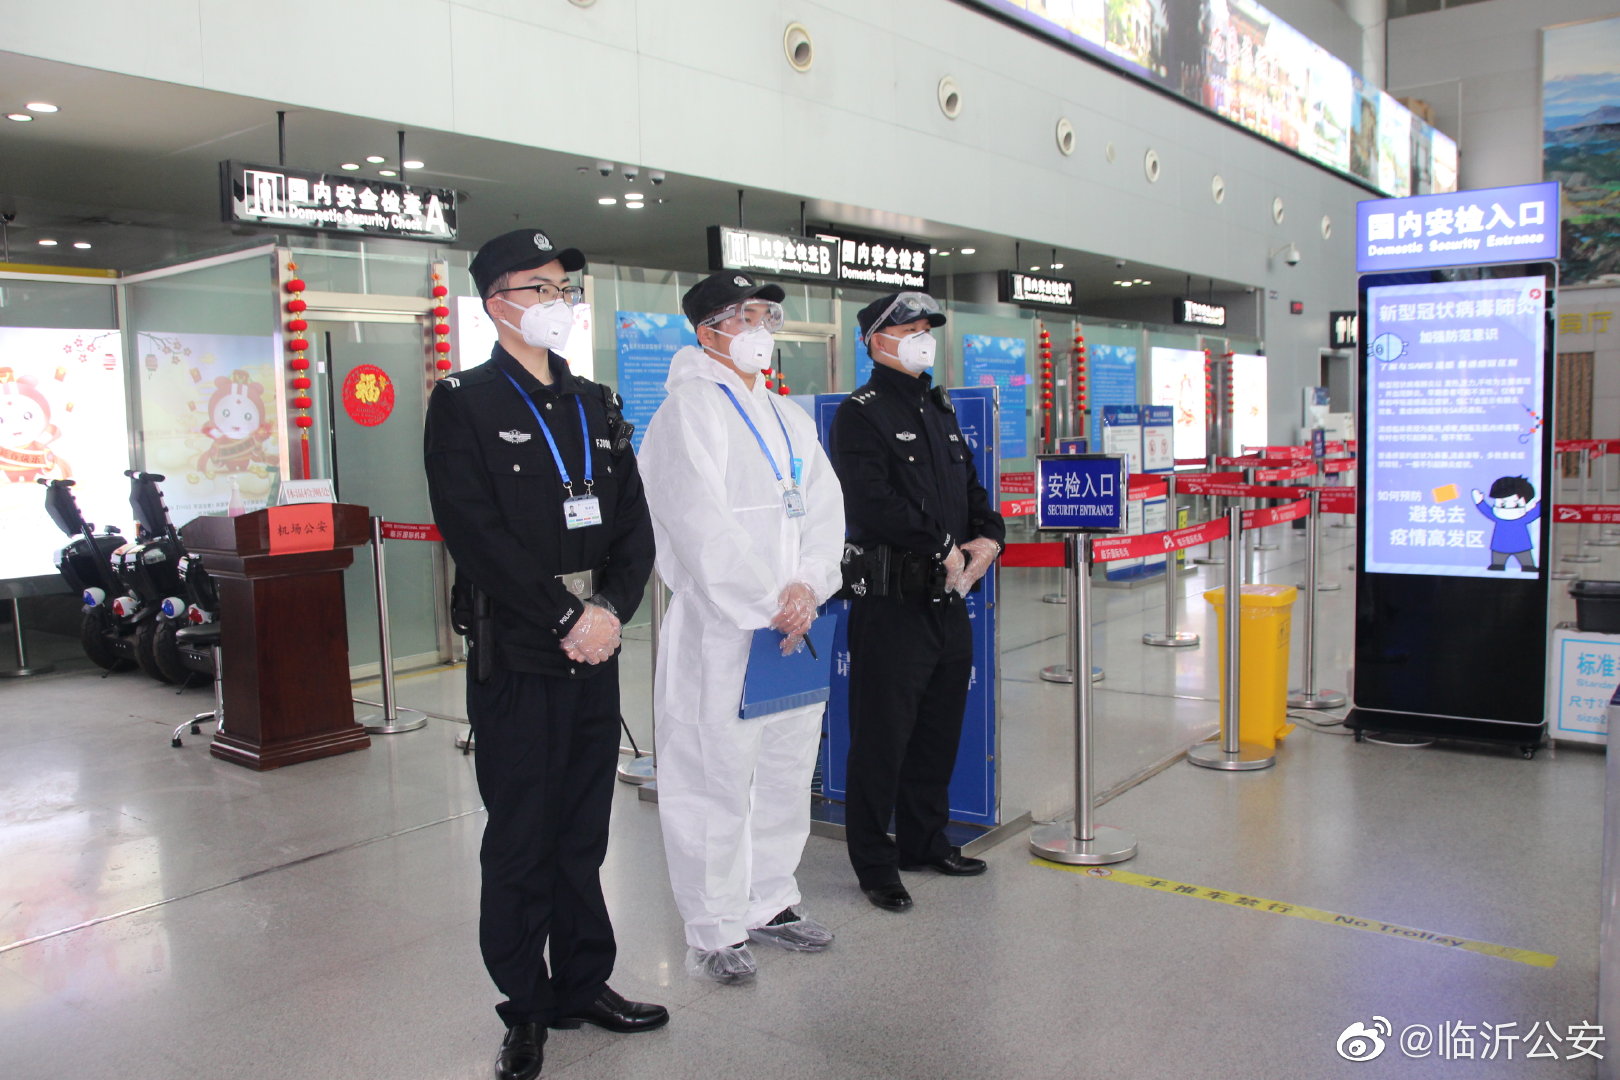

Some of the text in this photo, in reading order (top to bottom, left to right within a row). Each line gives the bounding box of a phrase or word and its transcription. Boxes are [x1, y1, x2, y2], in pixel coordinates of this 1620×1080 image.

[288, 177, 423, 216] 国内安全检查
[289, 204, 423, 231] Domestic Security Check
[427, 195, 447, 233] A
[1367, 201, 1545, 242] 国内安检入口
[842, 239, 925, 272] 国内安全检查
[1367, 233, 1545, 257] Domestic Security Entrance
[820, 246, 831, 275] B
[842, 265, 925, 288] Domestic Security Check
[1066, 282, 1073, 305] C
[1379, 299, 1536, 323] 新型冠状病毒肺炎
[1419, 328, 1499, 344] 加强防范意识
[1048, 471, 1114, 499] 安检入口
[1377, 490, 1422, 502] 如何预防
[1048, 504, 1079, 516] SECURITY
[1079, 504, 1114, 516] ENTRANCE
[1408, 505, 1466, 524] 避免去
[277, 521, 328, 537] 机场公安
[1389, 527, 1485, 549] 疫情高发区
[559, 607, 575, 625] POLICE
[1577, 653, 1620, 677] 标准
[1145, 878, 1294, 913] 手推车禁行
[1334, 915, 1466, 947] No Trolley
